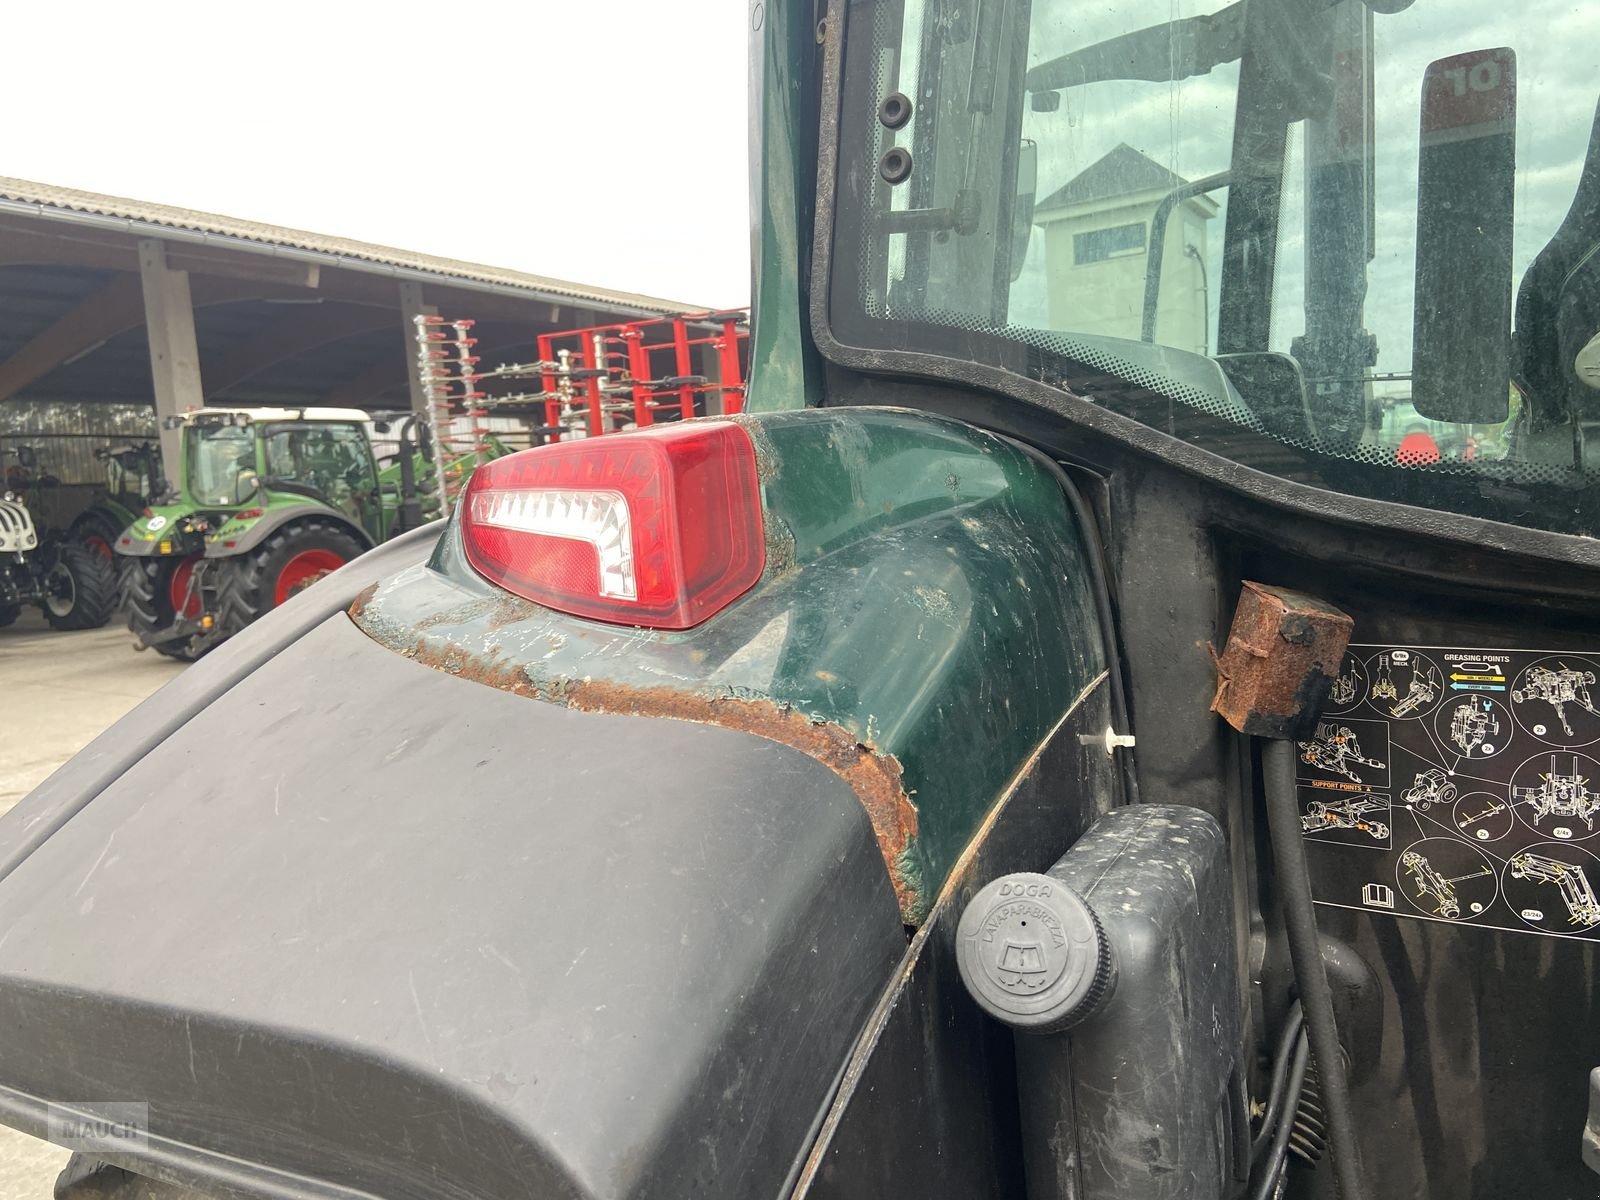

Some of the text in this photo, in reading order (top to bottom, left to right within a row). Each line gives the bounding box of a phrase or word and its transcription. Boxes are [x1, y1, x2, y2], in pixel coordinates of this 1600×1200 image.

[1444, 653, 1510, 663] GREASING POINTS
[1312, 780, 1362, 791] SUPPORT POINTS
[999, 883, 1053, 898] DOGA
[983, 904, 1066, 950] LAVAPARABREZZA
